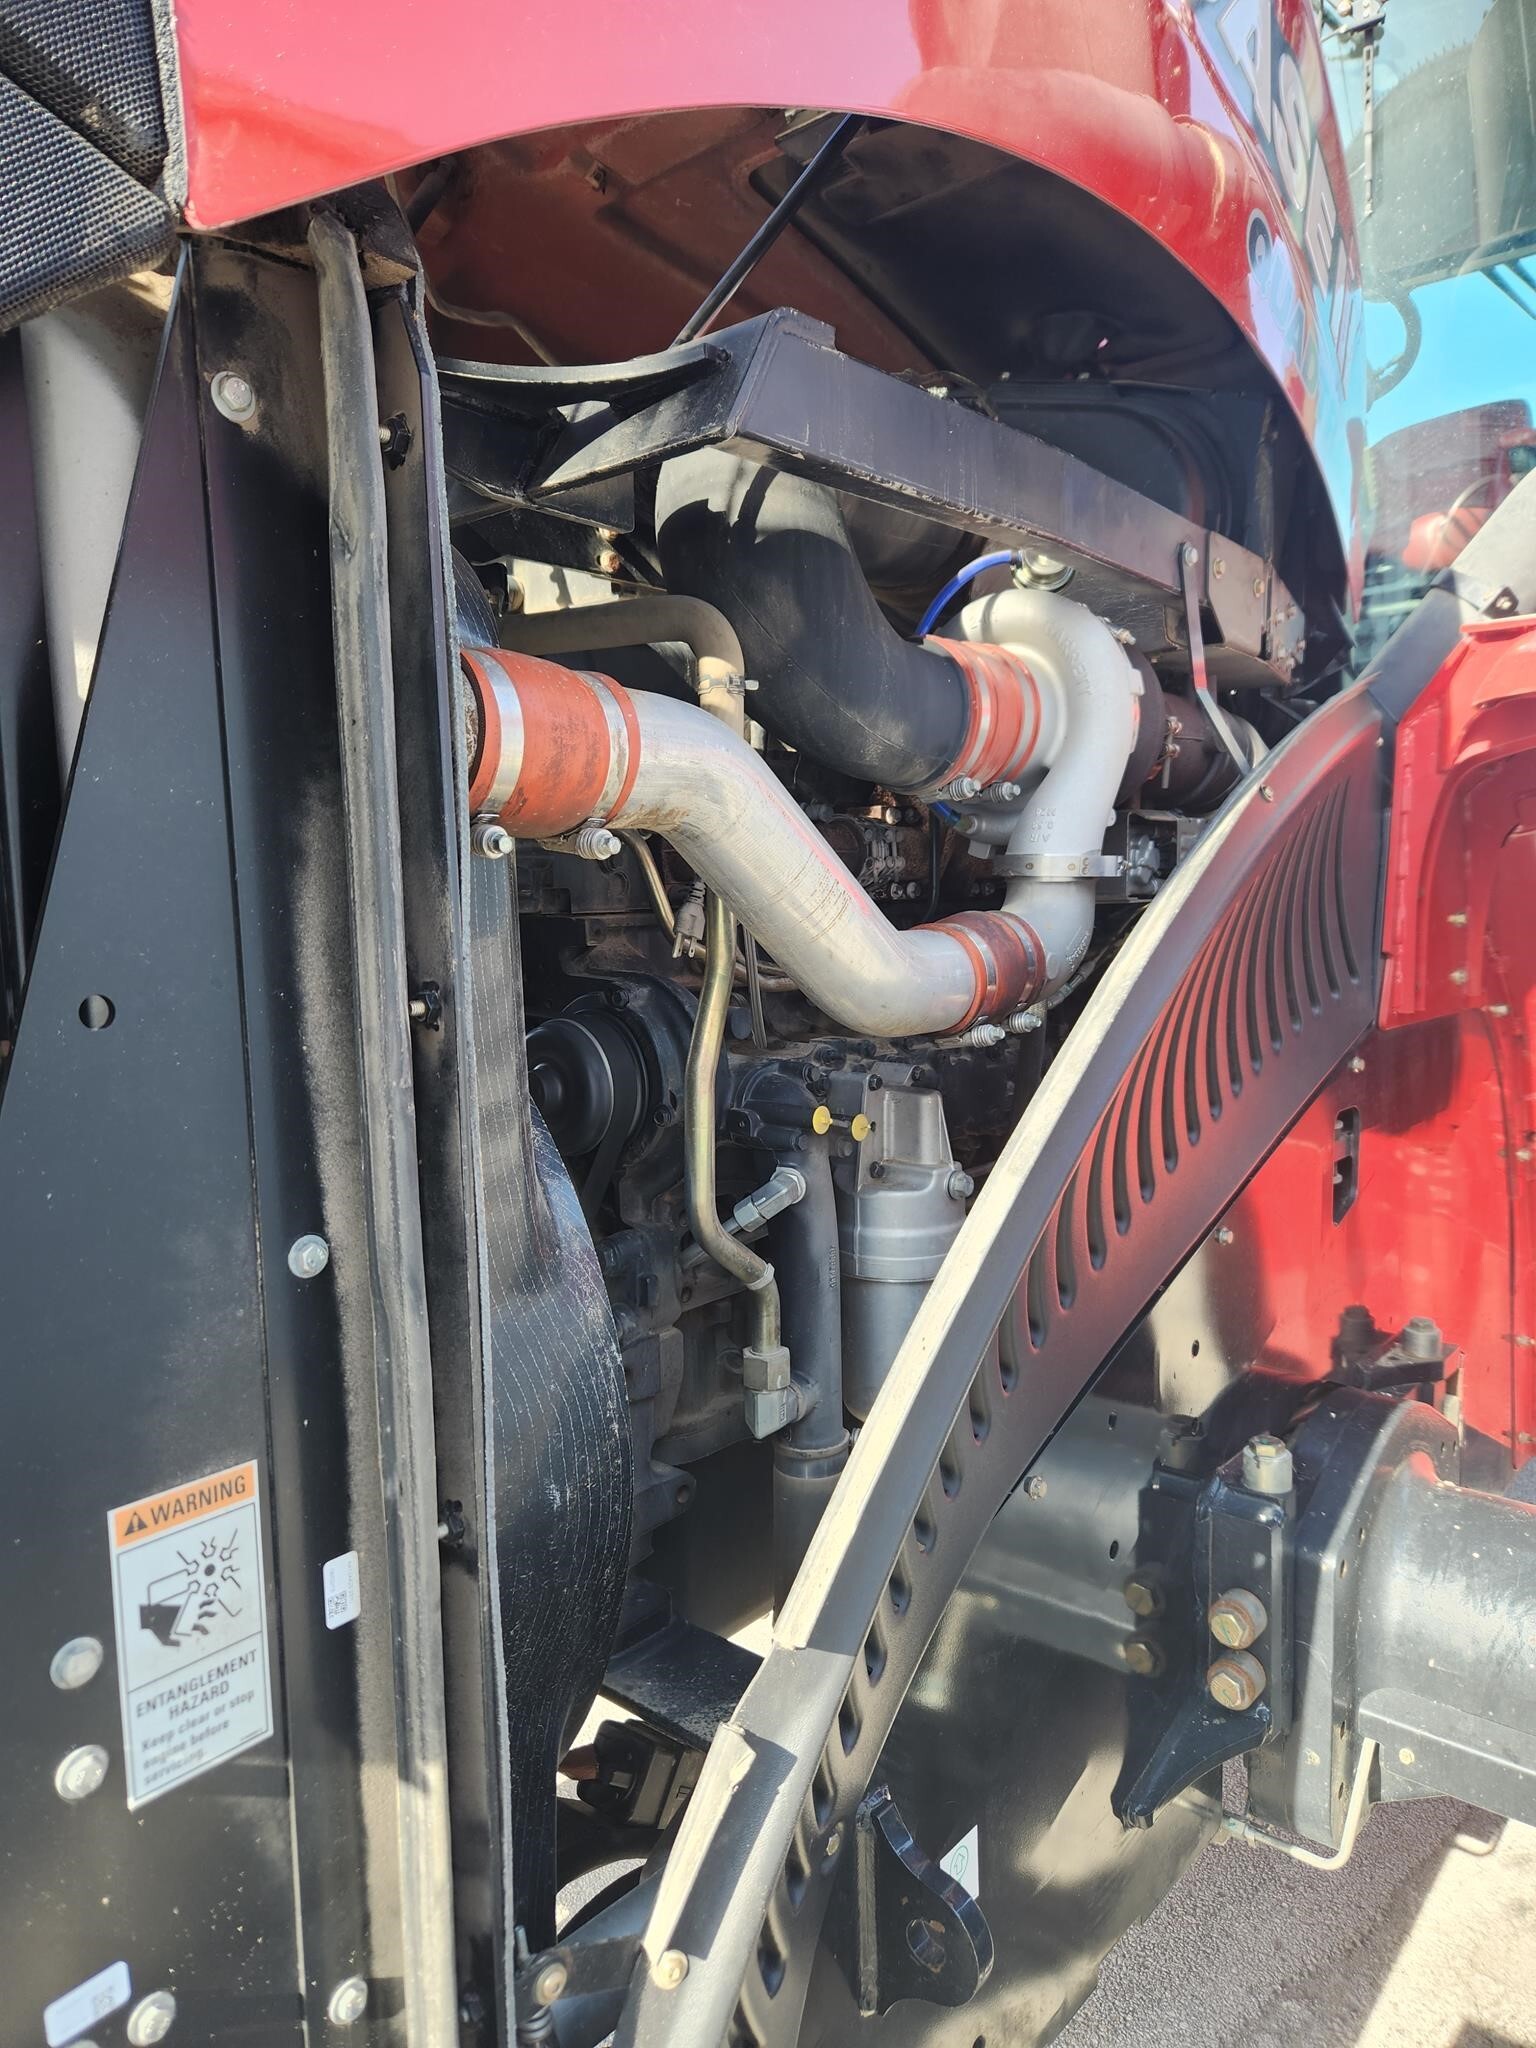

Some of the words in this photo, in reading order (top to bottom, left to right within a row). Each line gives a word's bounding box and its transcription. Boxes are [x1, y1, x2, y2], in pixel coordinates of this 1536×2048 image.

[151, 1475, 246, 1525] WARNING
[136, 1649, 257, 1718] ENTANGLEMENT
[169, 1680, 230, 1720] HAZARD
[142, 1729, 174, 1752] Keep
[178, 1711, 210, 1734] clear
[213, 1704, 226, 1717] or
[229, 1690, 255, 1710] stop
[143, 1741, 186, 1770] engine
[190, 1719, 230, 1745] before
